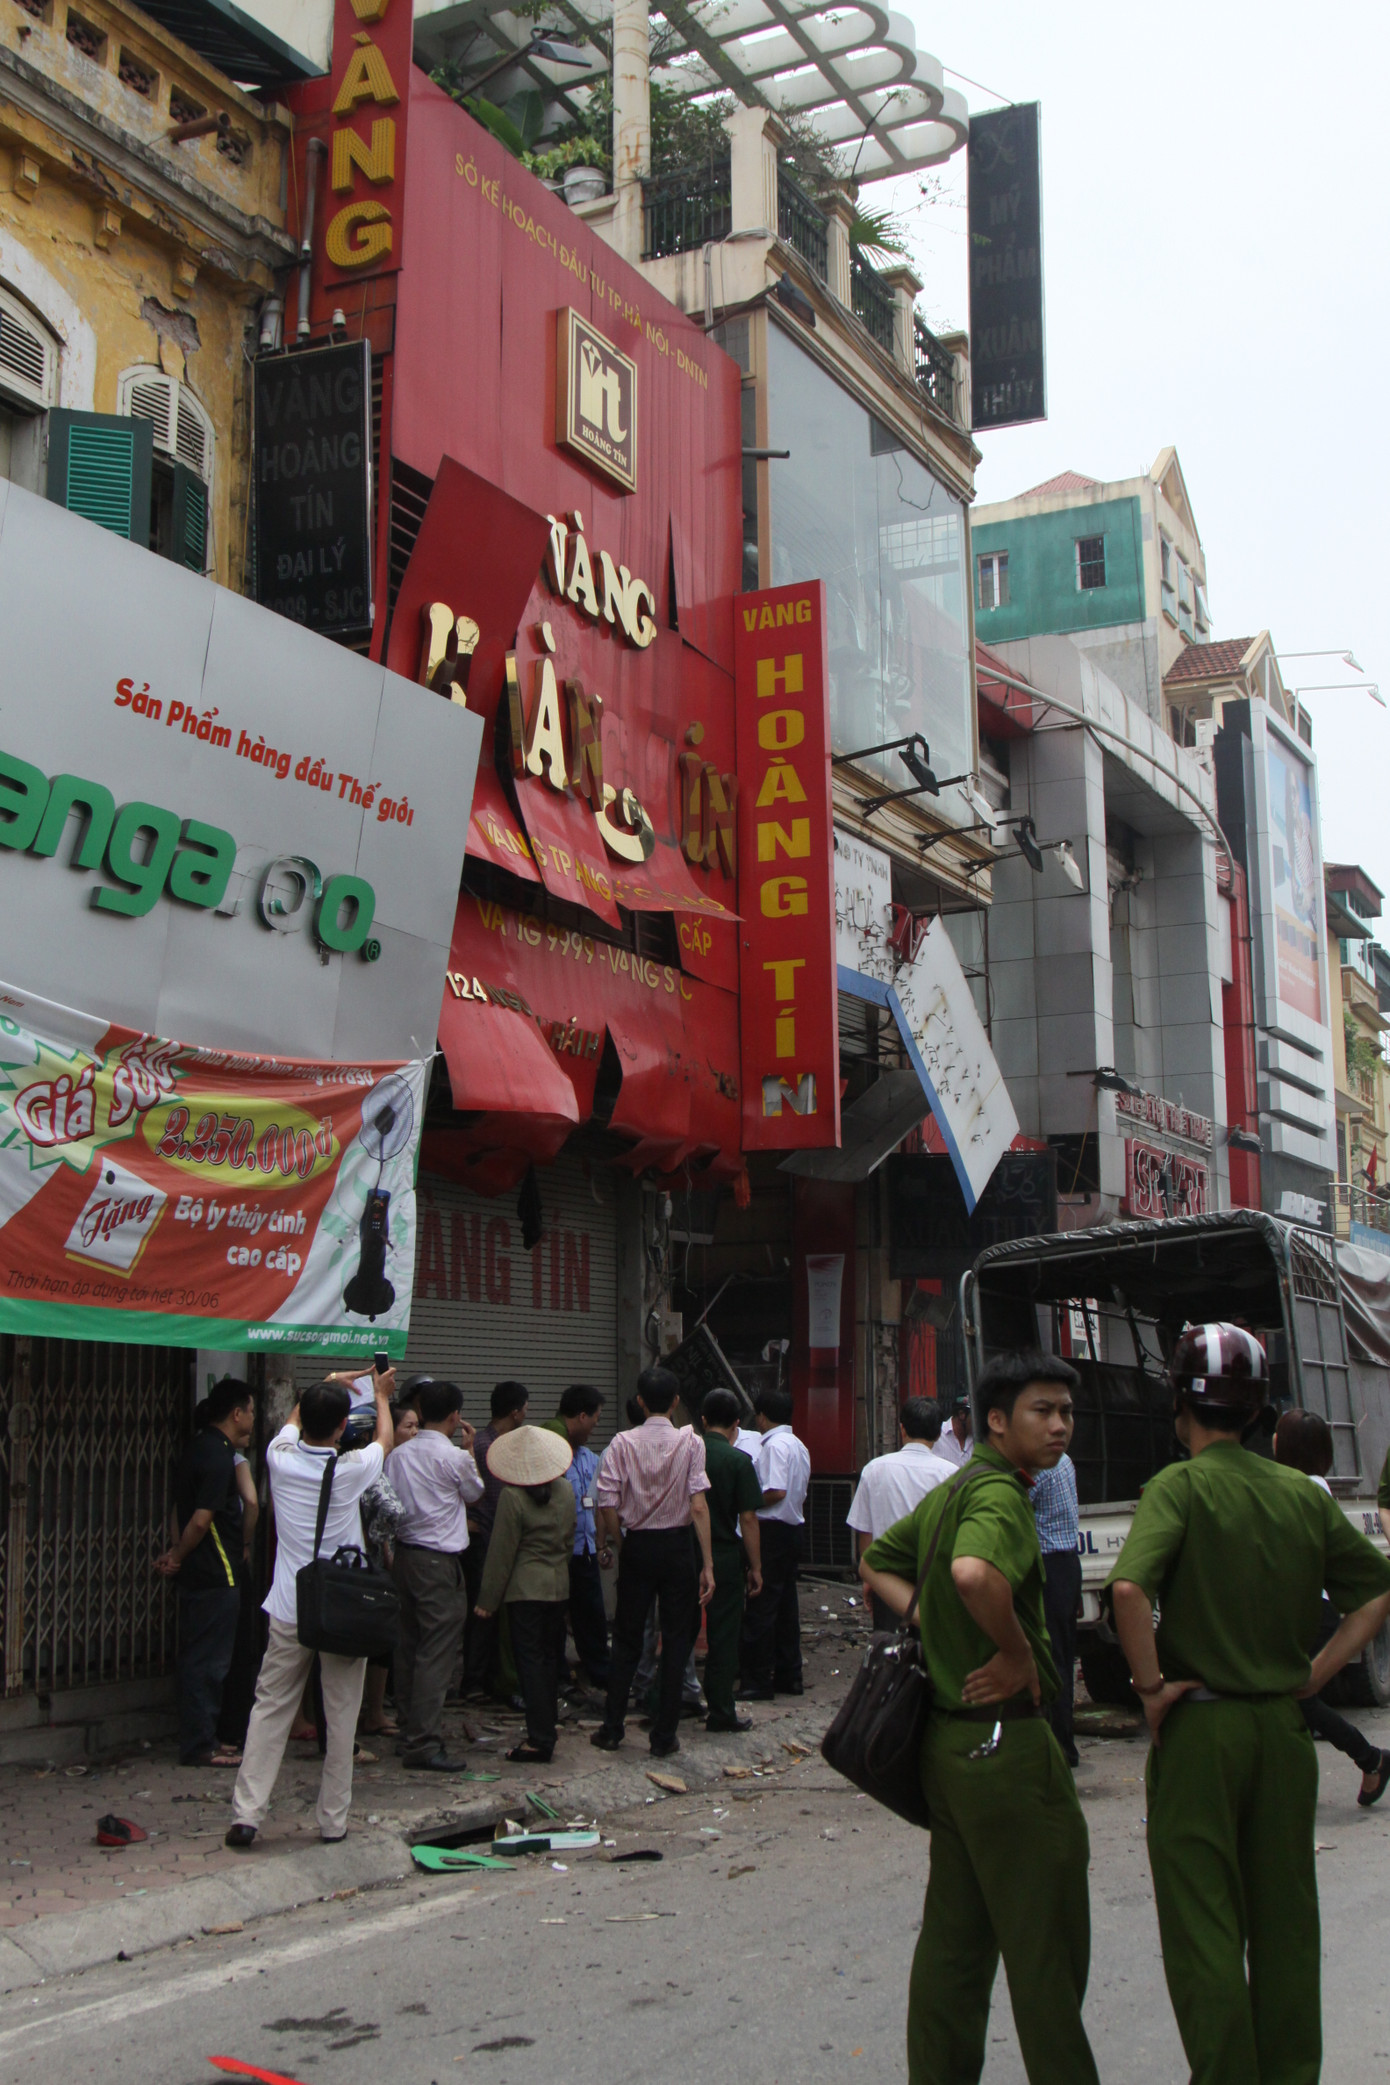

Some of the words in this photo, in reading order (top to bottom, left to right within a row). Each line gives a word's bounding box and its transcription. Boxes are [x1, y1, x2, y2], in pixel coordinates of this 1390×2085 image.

[455, 153, 478, 188] SỞ
[481, 175, 501, 208] KẾ
[559, 245, 587, 283] ĐẦU
[646, 320, 669, 357] NỘI
[676, 348, 708, 391] DNTN
[261, 364, 361, 426] VÀNG
[261, 427, 360, 482] HOÀNG
[582, 424, 612, 456] HOÀNG
[613, 448, 627, 468] TÍN
[290, 485, 333, 531] TÍN
[278, 549, 313, 582] ĐẠI
[320, 536, 346, 574] LÝ
[547, 510, 656, 648] VÀNG
[325, 587, 363, 620] SJC
[743, 599, 812, 632] VÀNG
[114, 678, 162, 720] Sản
[166, 700, 232, 748] Phẩm
[236, 730, 291, 779] hàng
[295, 756, 333, 791] đầu
[338, 774, 382, 809] Thế
[376, 796, 414, 827] giới
[755, 654, 811, 918] HOÀNG
[546, 926, 595, 964] 9999
[680, 918, 712, 957] CẤP
[446, 971, 488, 1002] 124
[14, 1062, 96, 1148] Giá
[81, 1194, 154, 1248] Tặng
[174, 1195, 204, 1228] Bộ
[206, 1199, 227, 1231] ly
[227, 1203, 268, 1236] thủy
[227, 1245, 262, 1267] cao
[265, 1244, 301, 1277] cấp
[416, 1188, 511, 1306] ÀNG
[6, 1270, 39, 1289] Thời
[40, 1275, 69, 1296] hạn
[71, 1279, 90, 1299] áp
[92, 1281, 130, 1304] dụng
[175, 1289, 220, 1309] 30/06
[247, 1327, 389, 1346] www.sucsongmoi.net.vn
